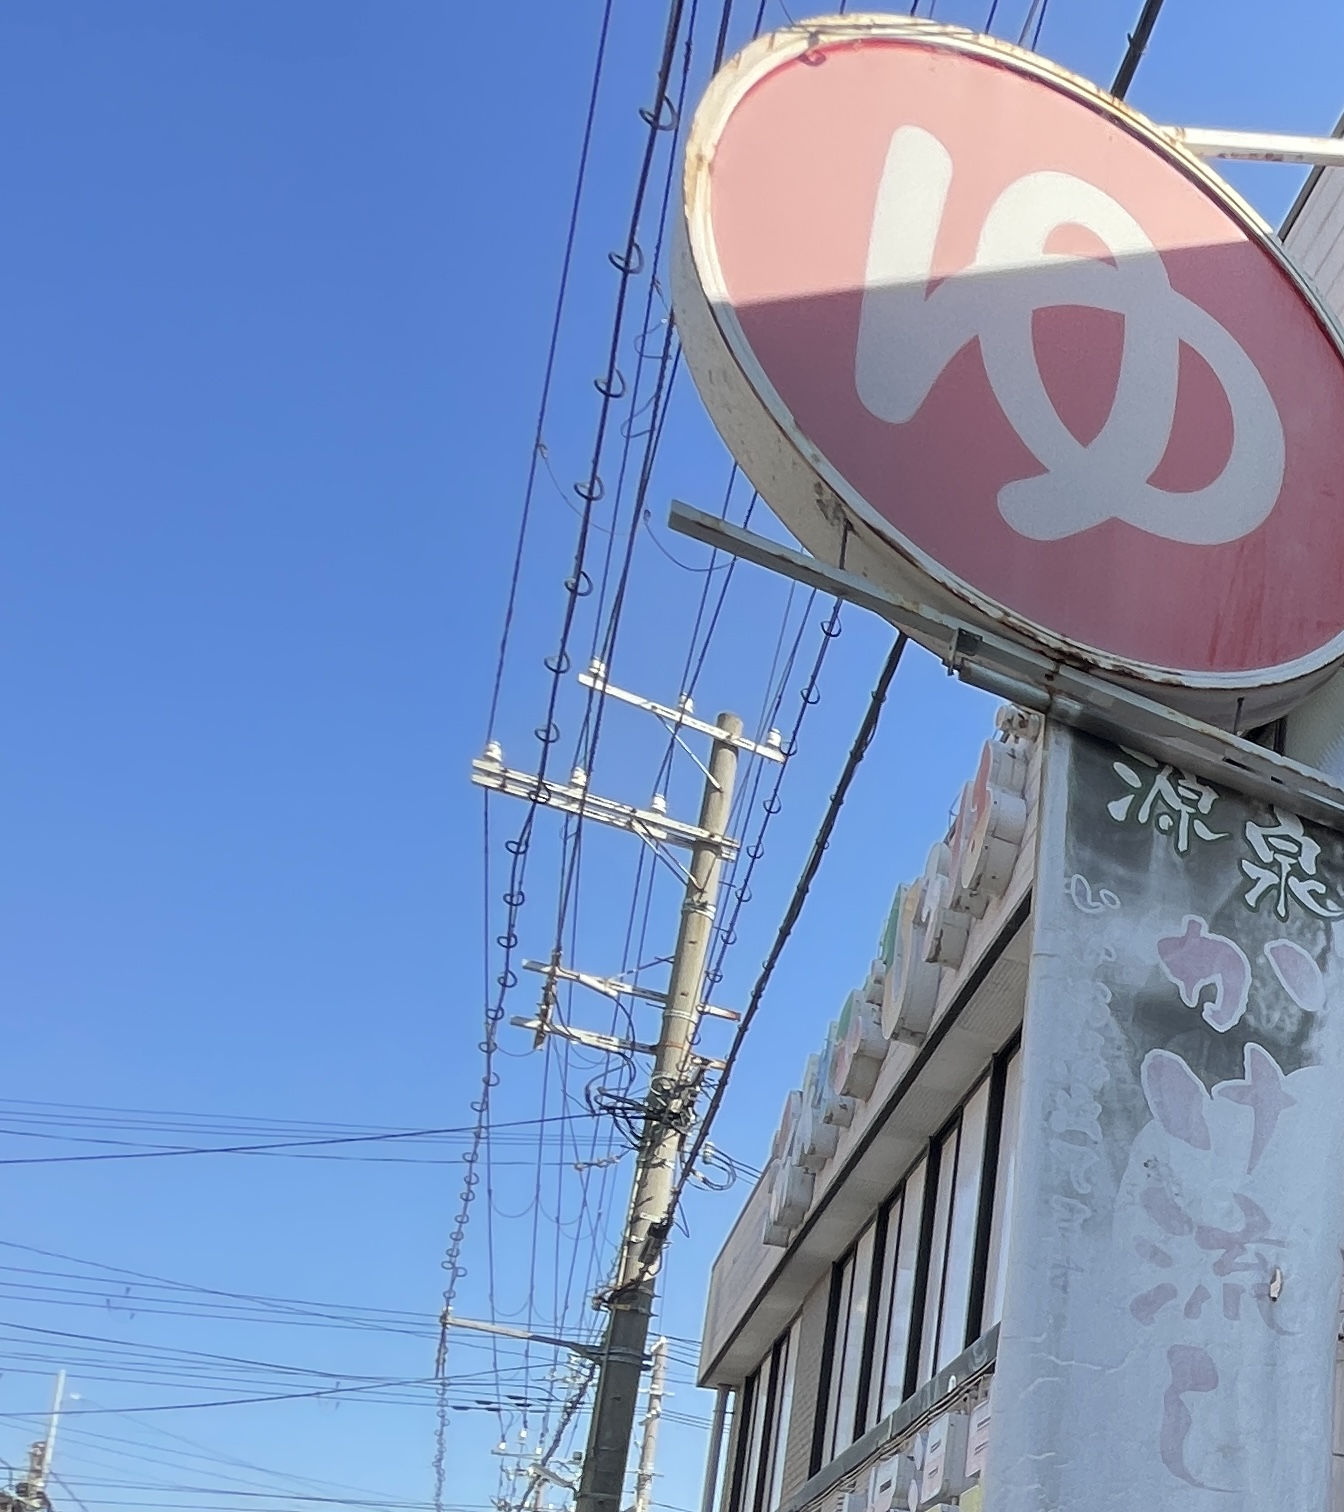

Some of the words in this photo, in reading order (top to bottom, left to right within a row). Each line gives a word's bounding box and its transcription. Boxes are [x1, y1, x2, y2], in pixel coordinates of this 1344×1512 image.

[855, 124, 1285, 546] ゆ
[1129, 915, 1327, 1494] かけ流し
